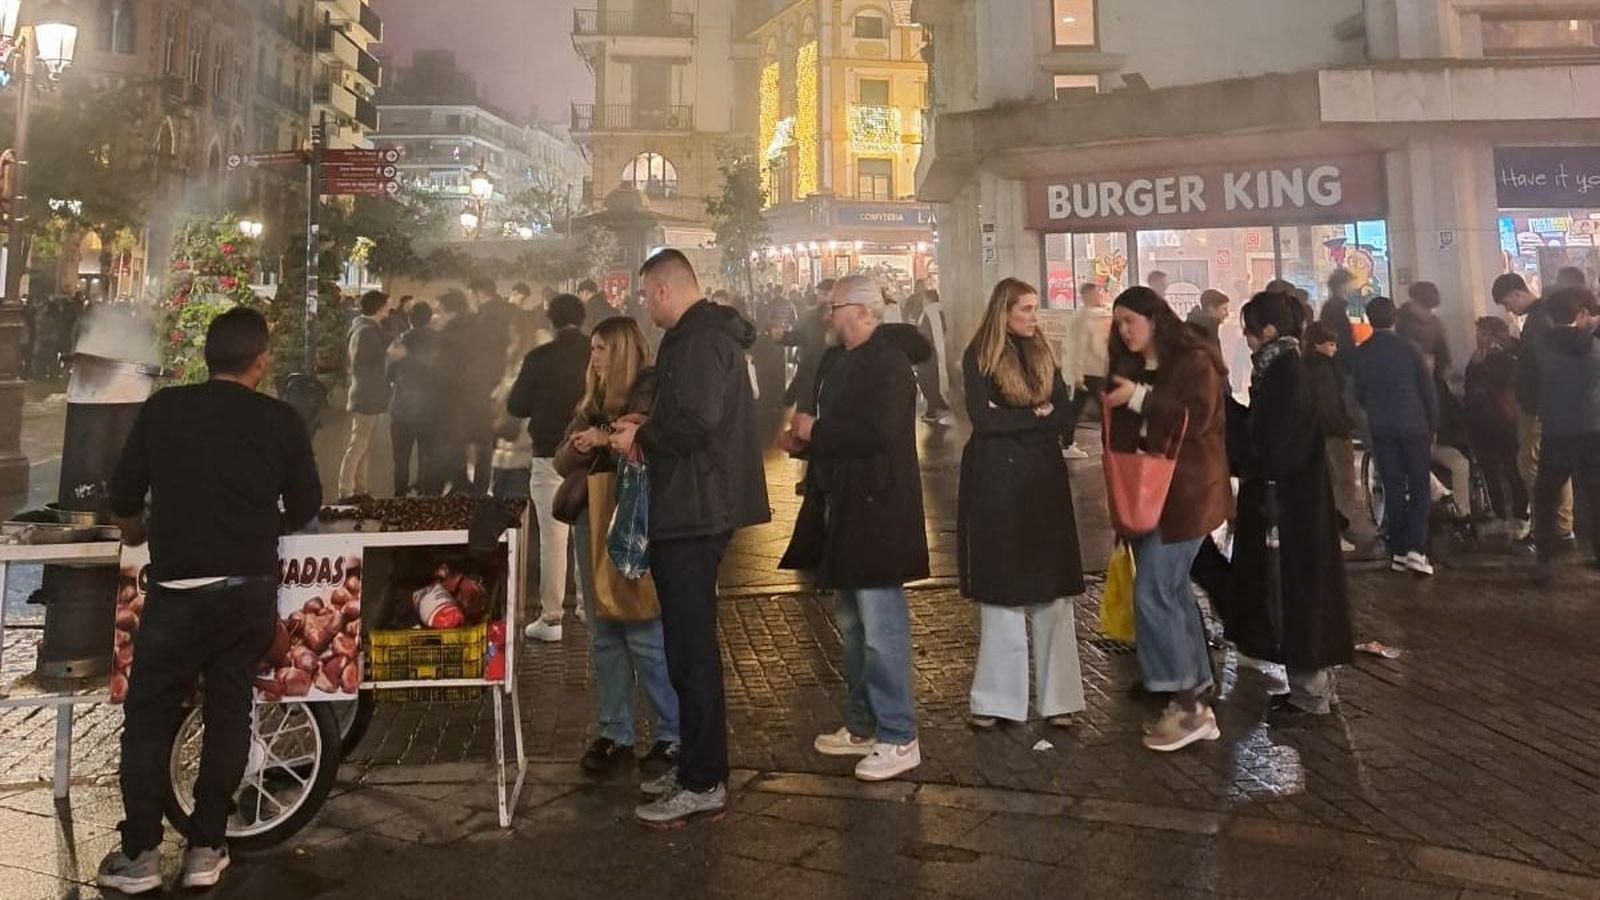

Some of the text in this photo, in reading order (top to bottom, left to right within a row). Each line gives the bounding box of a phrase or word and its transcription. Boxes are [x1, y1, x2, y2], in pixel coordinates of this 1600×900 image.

[1047, 165, 1342, 220] BURGER KING
[1502, 168, 1546, 188] Have
[1555, 163, 1568, 190] it
